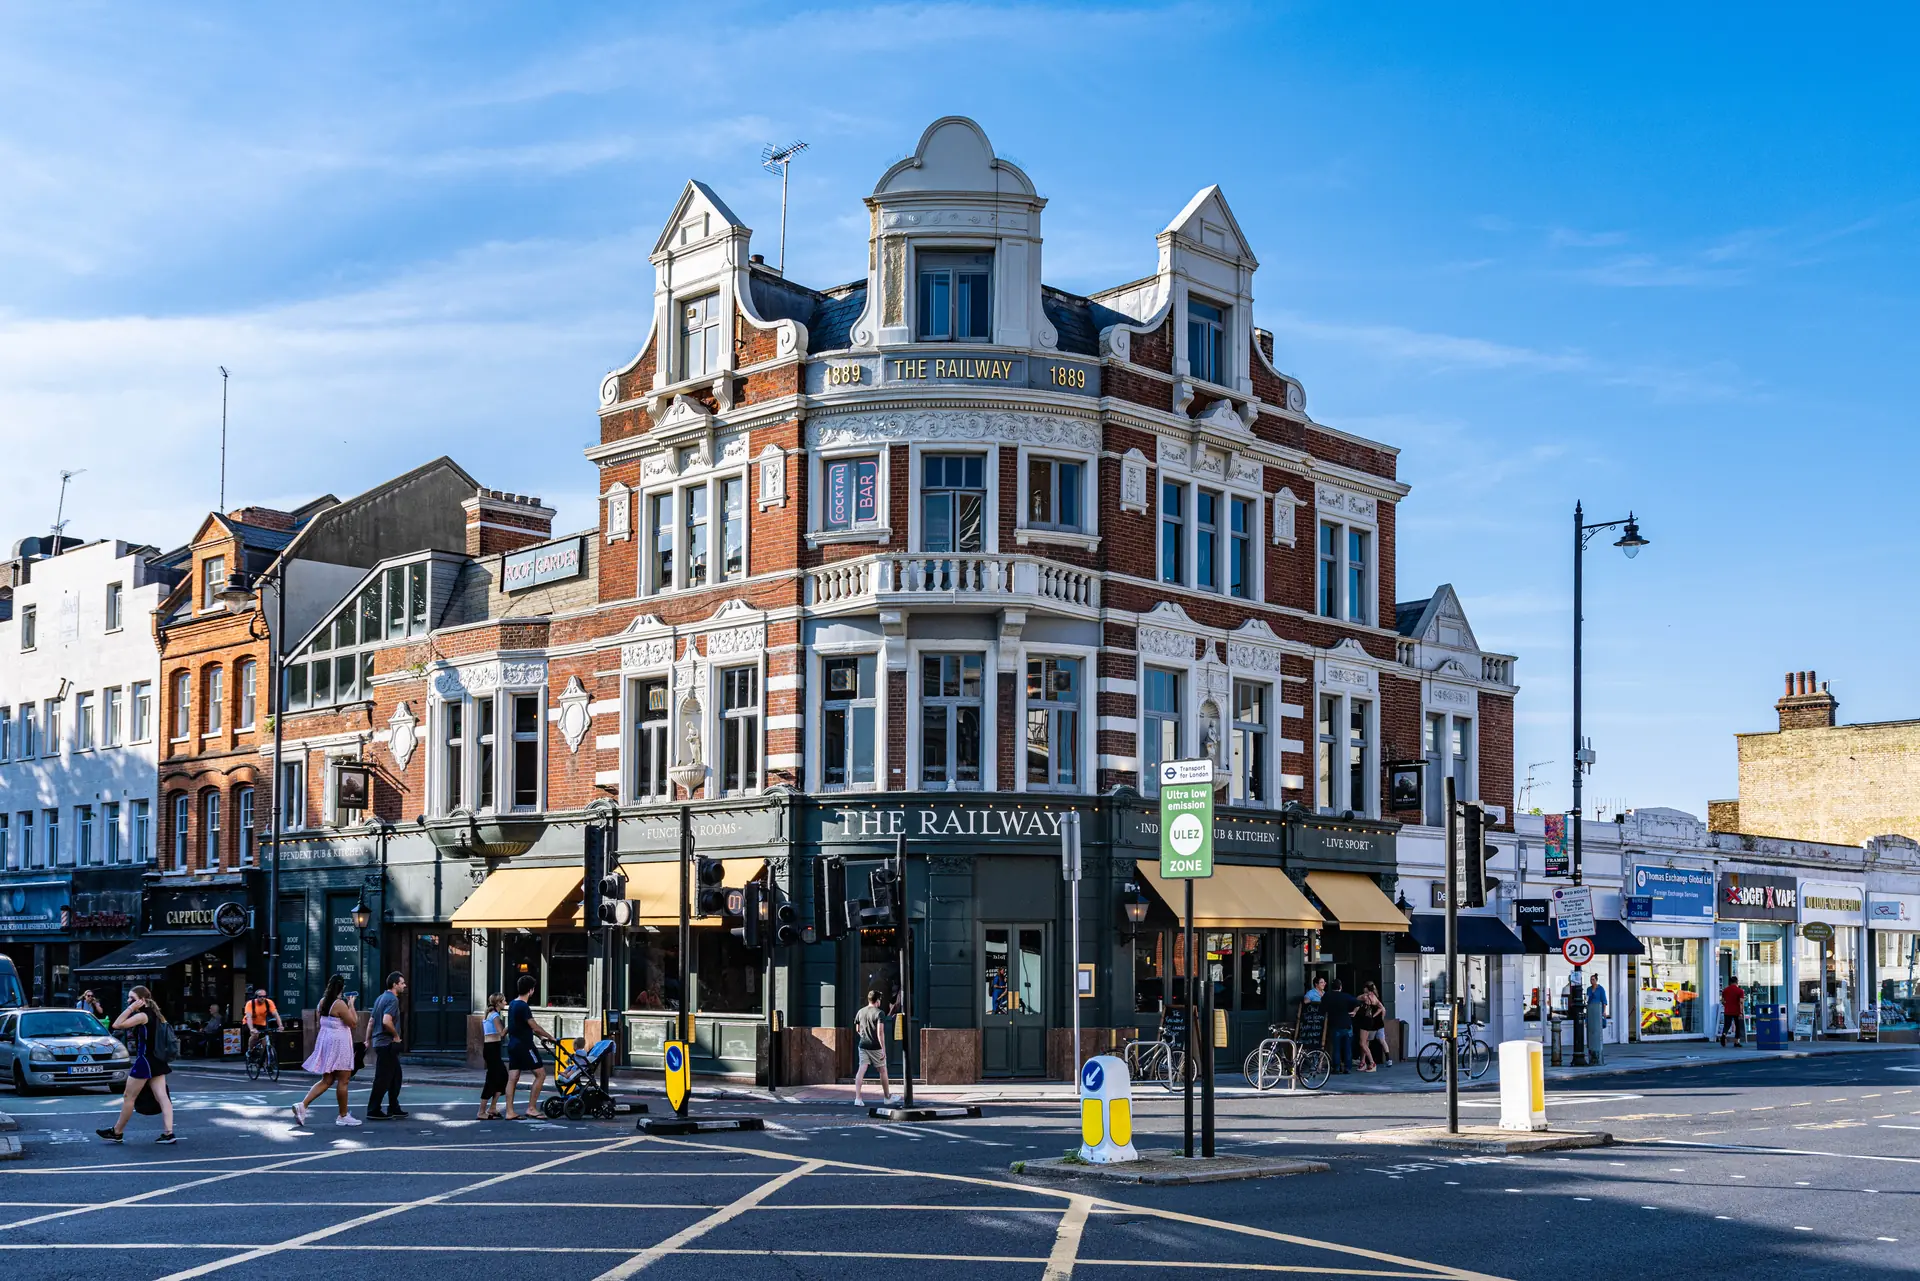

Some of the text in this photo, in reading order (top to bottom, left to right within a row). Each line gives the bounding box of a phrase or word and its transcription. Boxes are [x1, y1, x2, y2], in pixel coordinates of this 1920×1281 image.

[824, 363, 861, 385] 1889
[894, 359, 1012, 379] THE RAILWAY
[1050, 366, 1085, 388] 1889
[835, 467, 845, 521] COCKTAIL
[859, 474, 874, 508] BAR
[504, 547, 579, 581] ROOF GARDEN
[1180, 765, 1206, 773] Transport
[1166, 789, 1207, 800] Ultra low
[1167, 800, 1206, 811] emission
[835, 809, 1063, 836] THE RAILWAY
[647, 823, 736, 839] FUNCTN ROOMS
[1173, 829, 1200, 840] ULEZ
[1213, 829, 1275, 843] UB & KITCHEN
[1326, 838, 1370, 850] LIVE SPORT
[268, 847, 364, 861] IEPENDENT PUB & KITCHEN
[1169, 860, 1203, 872] ZONE
[1645, 871, 1712, 885] Thomas Exchange Global Ltd
[1727, 886, 1764, 905] ADGET
[1775, 889, 1796, 907] VAPE
[1519, 905, 1545, 913] Dexters
[166, 909, 215, 925] CAPPUCCI
[1568, 943, 1590, 957] 20
[336, 964, 355, 972] PRIVATE
[287, 971, 297, 980] BBQ
[339, 972, 351, 980] IRE
